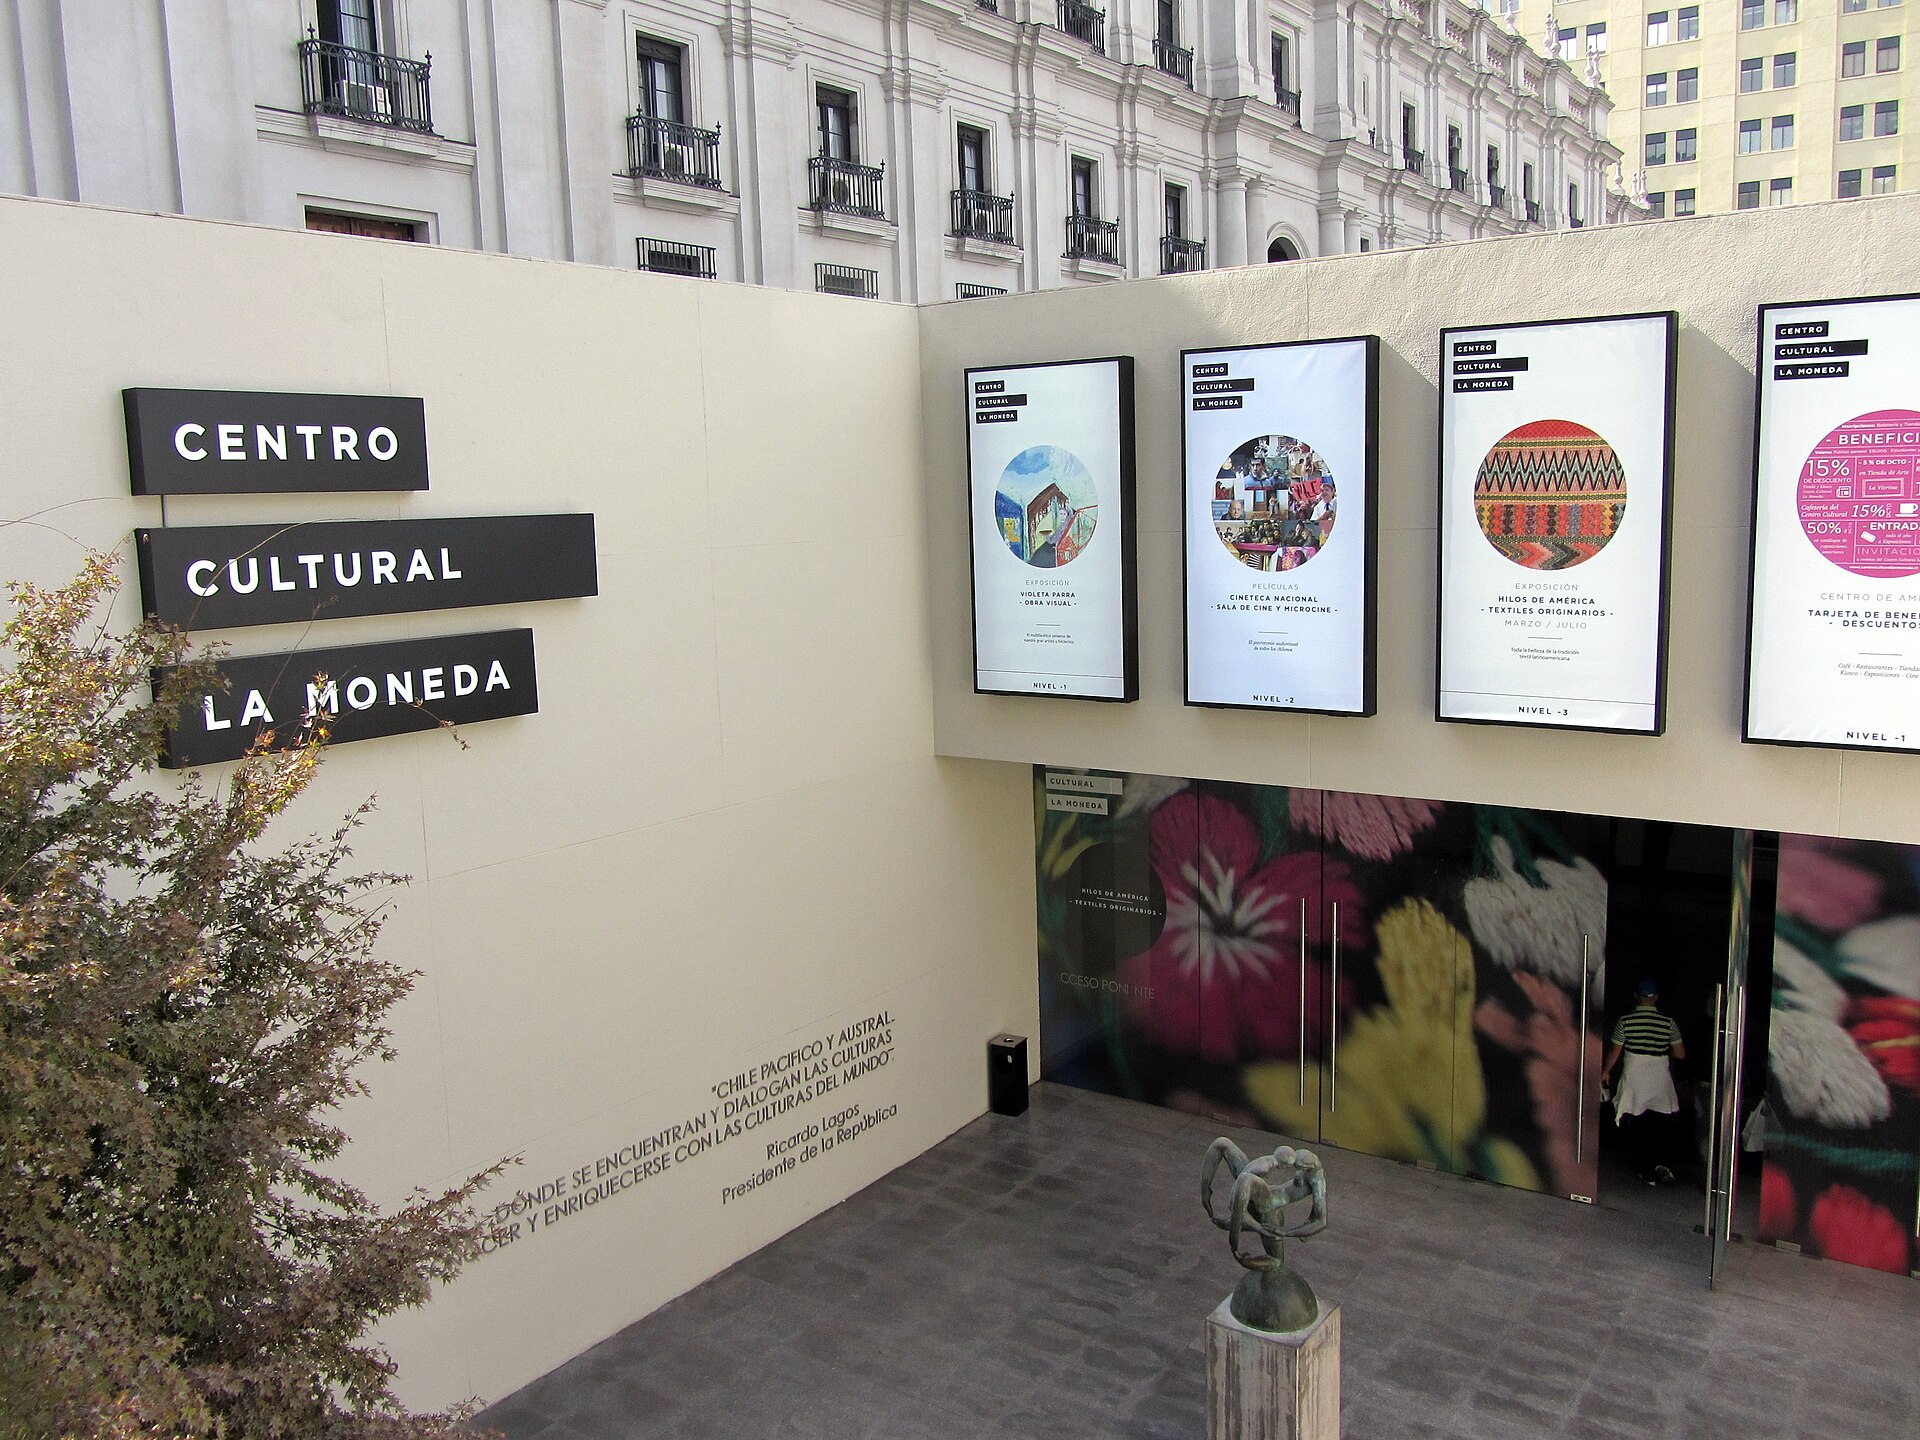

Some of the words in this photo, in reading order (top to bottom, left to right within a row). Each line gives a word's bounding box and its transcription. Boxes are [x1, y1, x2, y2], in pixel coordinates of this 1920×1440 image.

[1780, 325, 1823, 335] CENTRO
[1457, 344, 1492, 353] CENTRO
[1779, 345, 1835, 356] CULTURAL
[1195, 366, 1225, 374] CENTRO
[1457, 362, 1502, 371] CULTURAL
[1779, 368, 1793, 376] LA
[1797, 366, 1843, 375] MONEDA
[1195, 383, 1233, 391] CULTURAL
[1472, 380, 1509, 389] MONEDA
[978, 398, 1009, 406] CULTURAL
[1208, 399, 1239, 407] MONEDA
[174, 423, 399, 461] CENTRO
[1838, 432, 1920, 445] BENEFICI
[1806, 459, 1850, 477] 15%
[1851, 504, 1886, 518] 15%
[1807, 521, 1841, 534] 50%
[1869, 521, 1920, 531] ENTRAD
[186, 548, 462, 597] CULTURAL
[1252, 583, 1299, 591] PELÍCULAS
[1515, 582, 1579, 591] EXPOSICIÓN
[1229, 594, 1271, 602] CINETECA
[1274, 595, 1318, 603] NACIONAL
[1498, 595, 1528, 603] HILOS
[1531, 596, 1545, 604] DE
[1548, 596, 1596, 605] AMÉRICA
[1820, 592, 1870, 601] CENTRO
[1876, 593, 1893, 602] DE
[1488, 606, 1534, 615] TEXTILES
[1537, 607, 1606, 617] ORIGINARIOS
[1808, 609, 1859, 618] TARJETA
[1864, 611, 1880, 619] DE
[1504, 620, 1542, 628] MARZO
[1555, 621, 1588, 630] JULIO
[1863, 670, 1900, 678] Exposiciones
[1033, 682, 1057, 690] NIVEL
[203, 689, 274, 731] LA
[305, 659, 511, 720] MONEDA
[1252, 694, 1281, 703] NIVEL
[1518, 706, 1552, 715] NIVEL
[1557, 708, 1568, 716] -3
[1846, 731, 1888, 742] NIVEL
[1894, 734, 1905, 743] -1
[1049, 777, 1095, 788] CULTURAL
[1051, 798, 1062, 806] LA
[1066, 799, 1103, 810] MONEDA
[1081, 887, 1102, 896] HILOS
[1074, 899, 1107, 909] TEXTILES
[1109, 904, 1157, 916] ORIGINARIOS
[760, 1040, 823, 1081] PACIFICO
[826, 1034, 835, 1050] Y
[572, 1165, 592, 1189] SE
[596, 1113, 706, 1178] ENCUENTRAN
[710, 1106, 719, 1124] Y
[723, 1069, 801, 1119] DIALOGAN
[804, 1058, 829, 1081] LAS
[831, 1029, 893, 1067] CULTURAS
[766, 1123, 819, 1161] Ricardo
[822, 1104, 860, 1135] Lagos
[526, 1212, 538, 1233] Y
[544, 1152, 671, 1226] ENRIQUECERSE
[674, 1132, 712, 1163] CON
[715, 1119, 742, 1145] LAS
[744, 1085, 813, 1130] CULTURAS
[815, 1074, 840, 1097] DEL
[722, 1157, 796, 1205] Presidente
[799, 1145, 818, 1164] de
[821, 1136, 834, 1153] la
[836, 1104, 897, 1145] República
